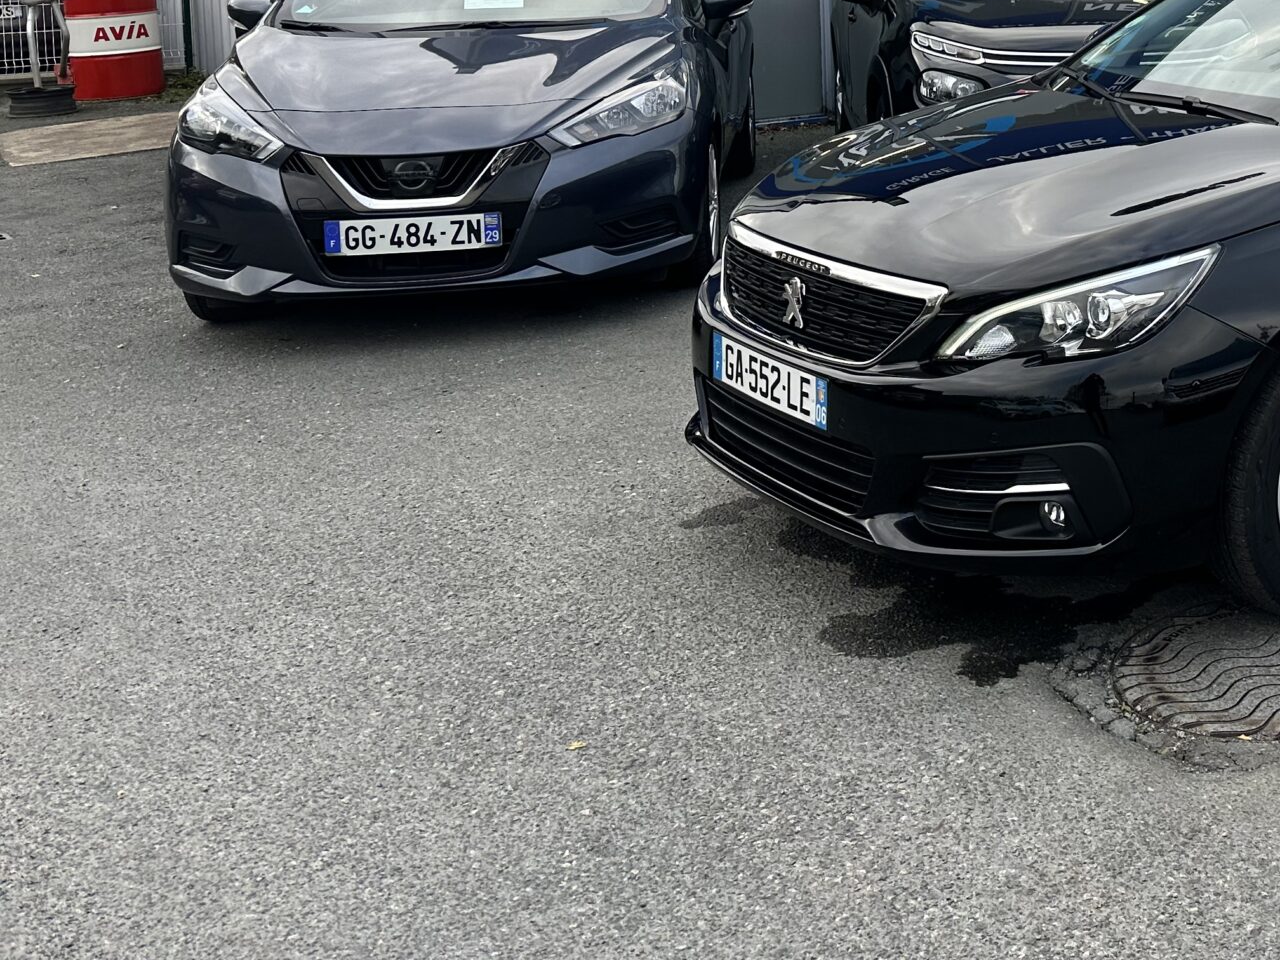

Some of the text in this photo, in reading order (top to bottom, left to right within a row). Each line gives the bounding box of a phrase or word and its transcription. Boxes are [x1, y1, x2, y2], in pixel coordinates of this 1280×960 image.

[330, 240, 336, 248] F
[344, 219, 482, 251] GG-484-ZN
[485, 230, 500, 242] 29
[780, 253, 826, 273] PEUGEOT
[725, 345, 811, 417] GA-552-LE
[815, 404, 827, 424] 06
